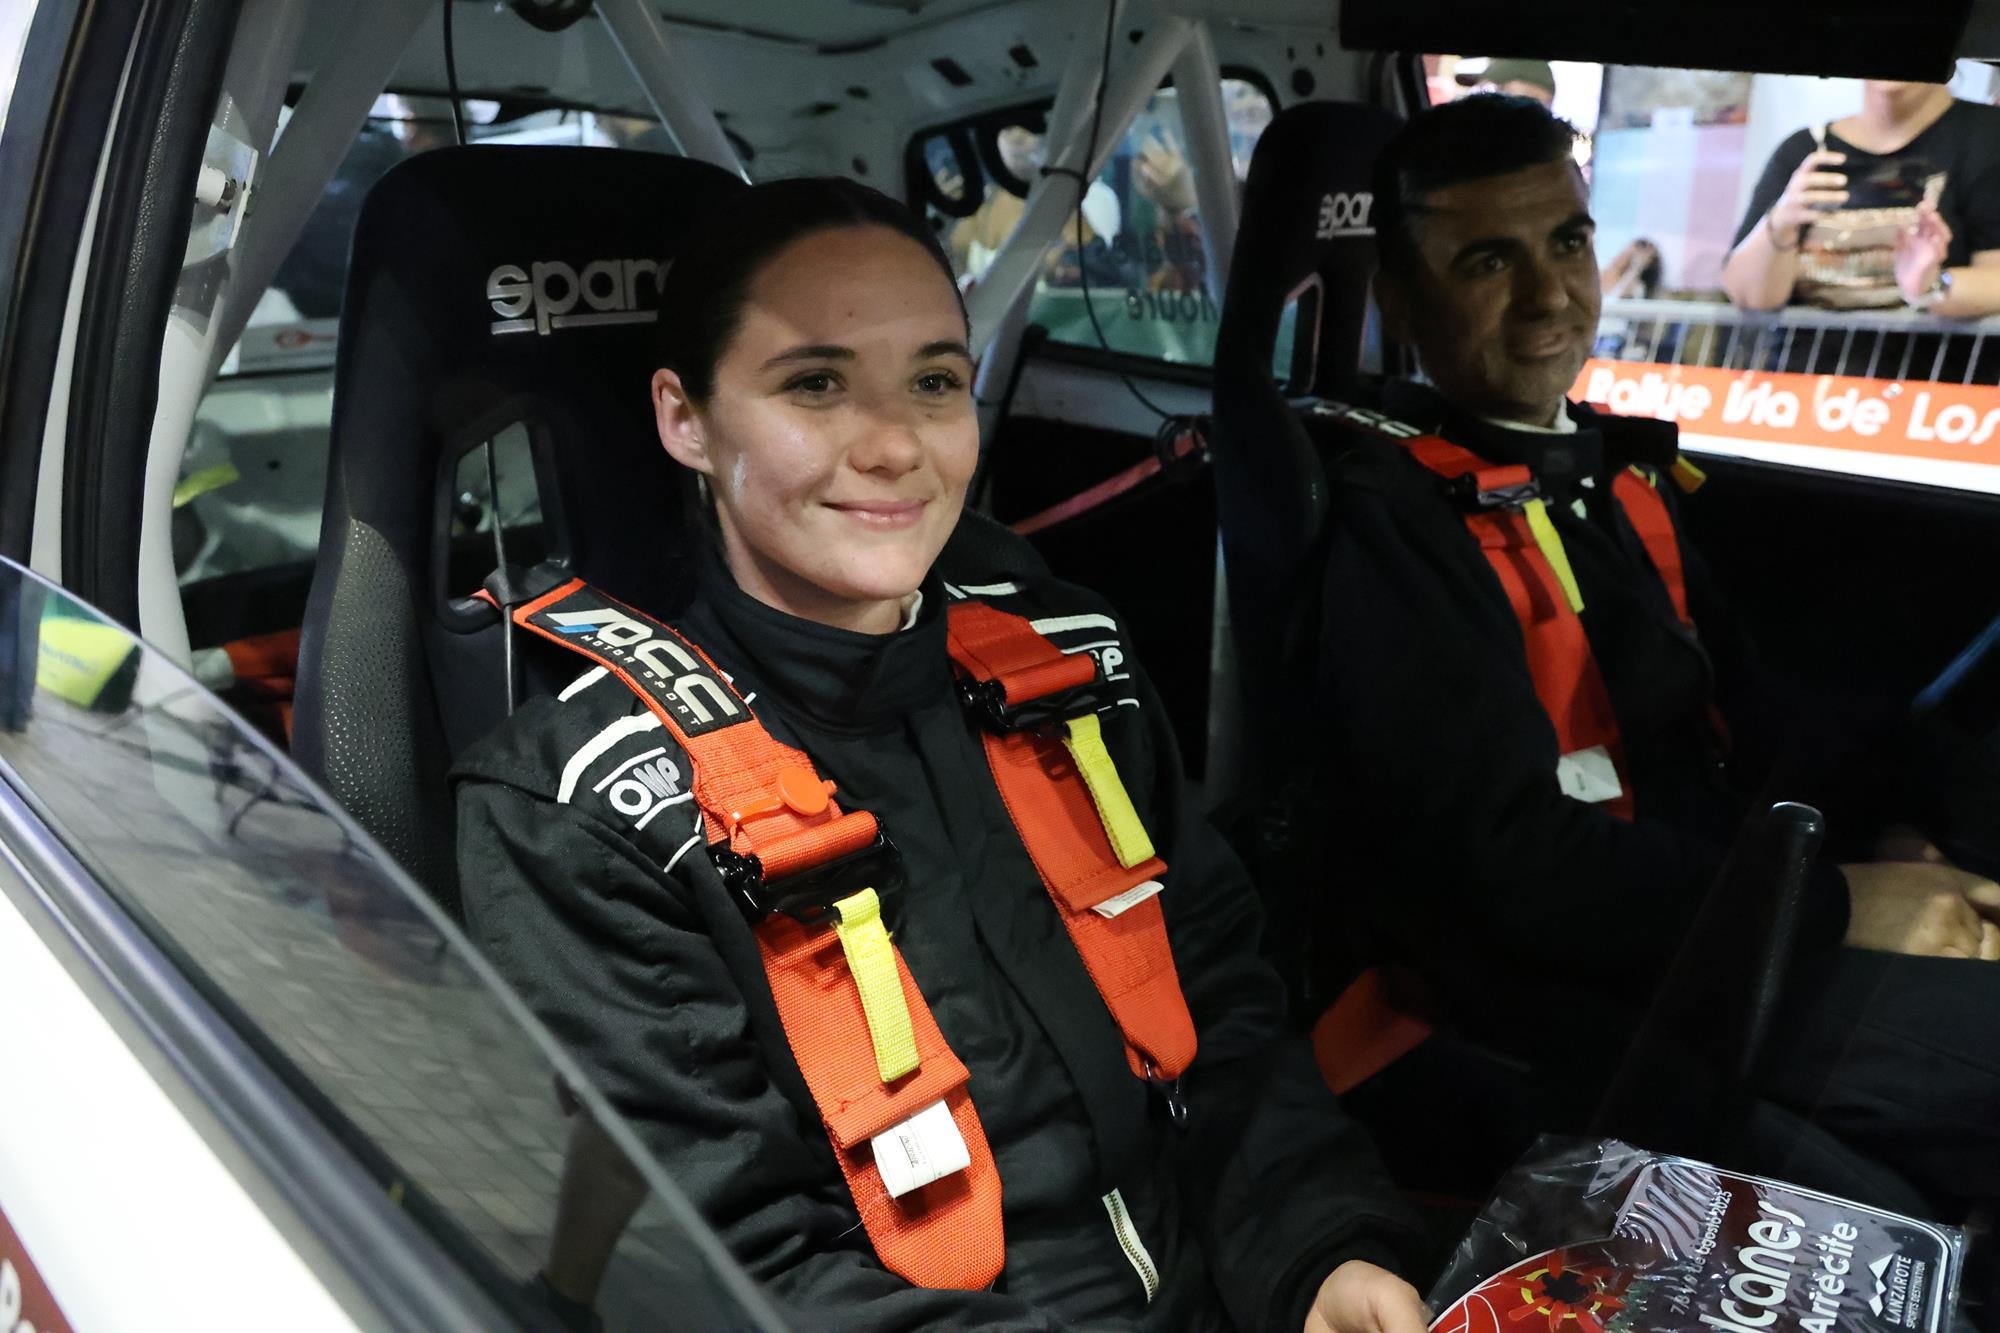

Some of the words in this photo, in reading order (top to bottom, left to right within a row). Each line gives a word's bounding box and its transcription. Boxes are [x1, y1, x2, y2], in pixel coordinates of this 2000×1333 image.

[487, 258, 676, 335] spar
[1585, 367, 1712, 421] Rallye
[580, 634, 637, 663] MOTOR
[642, 670, 701, 726] SPORT
[608, 756, 681, 816] OMP
[1713, 1190, 1733, 1217] 2025
[1885, 1255, 1913, 1326] LANZAROTE
[1912, 1259, 1926, 1303] DESTINATION
[1906, 1302, 1920, 1329] SPORTS
